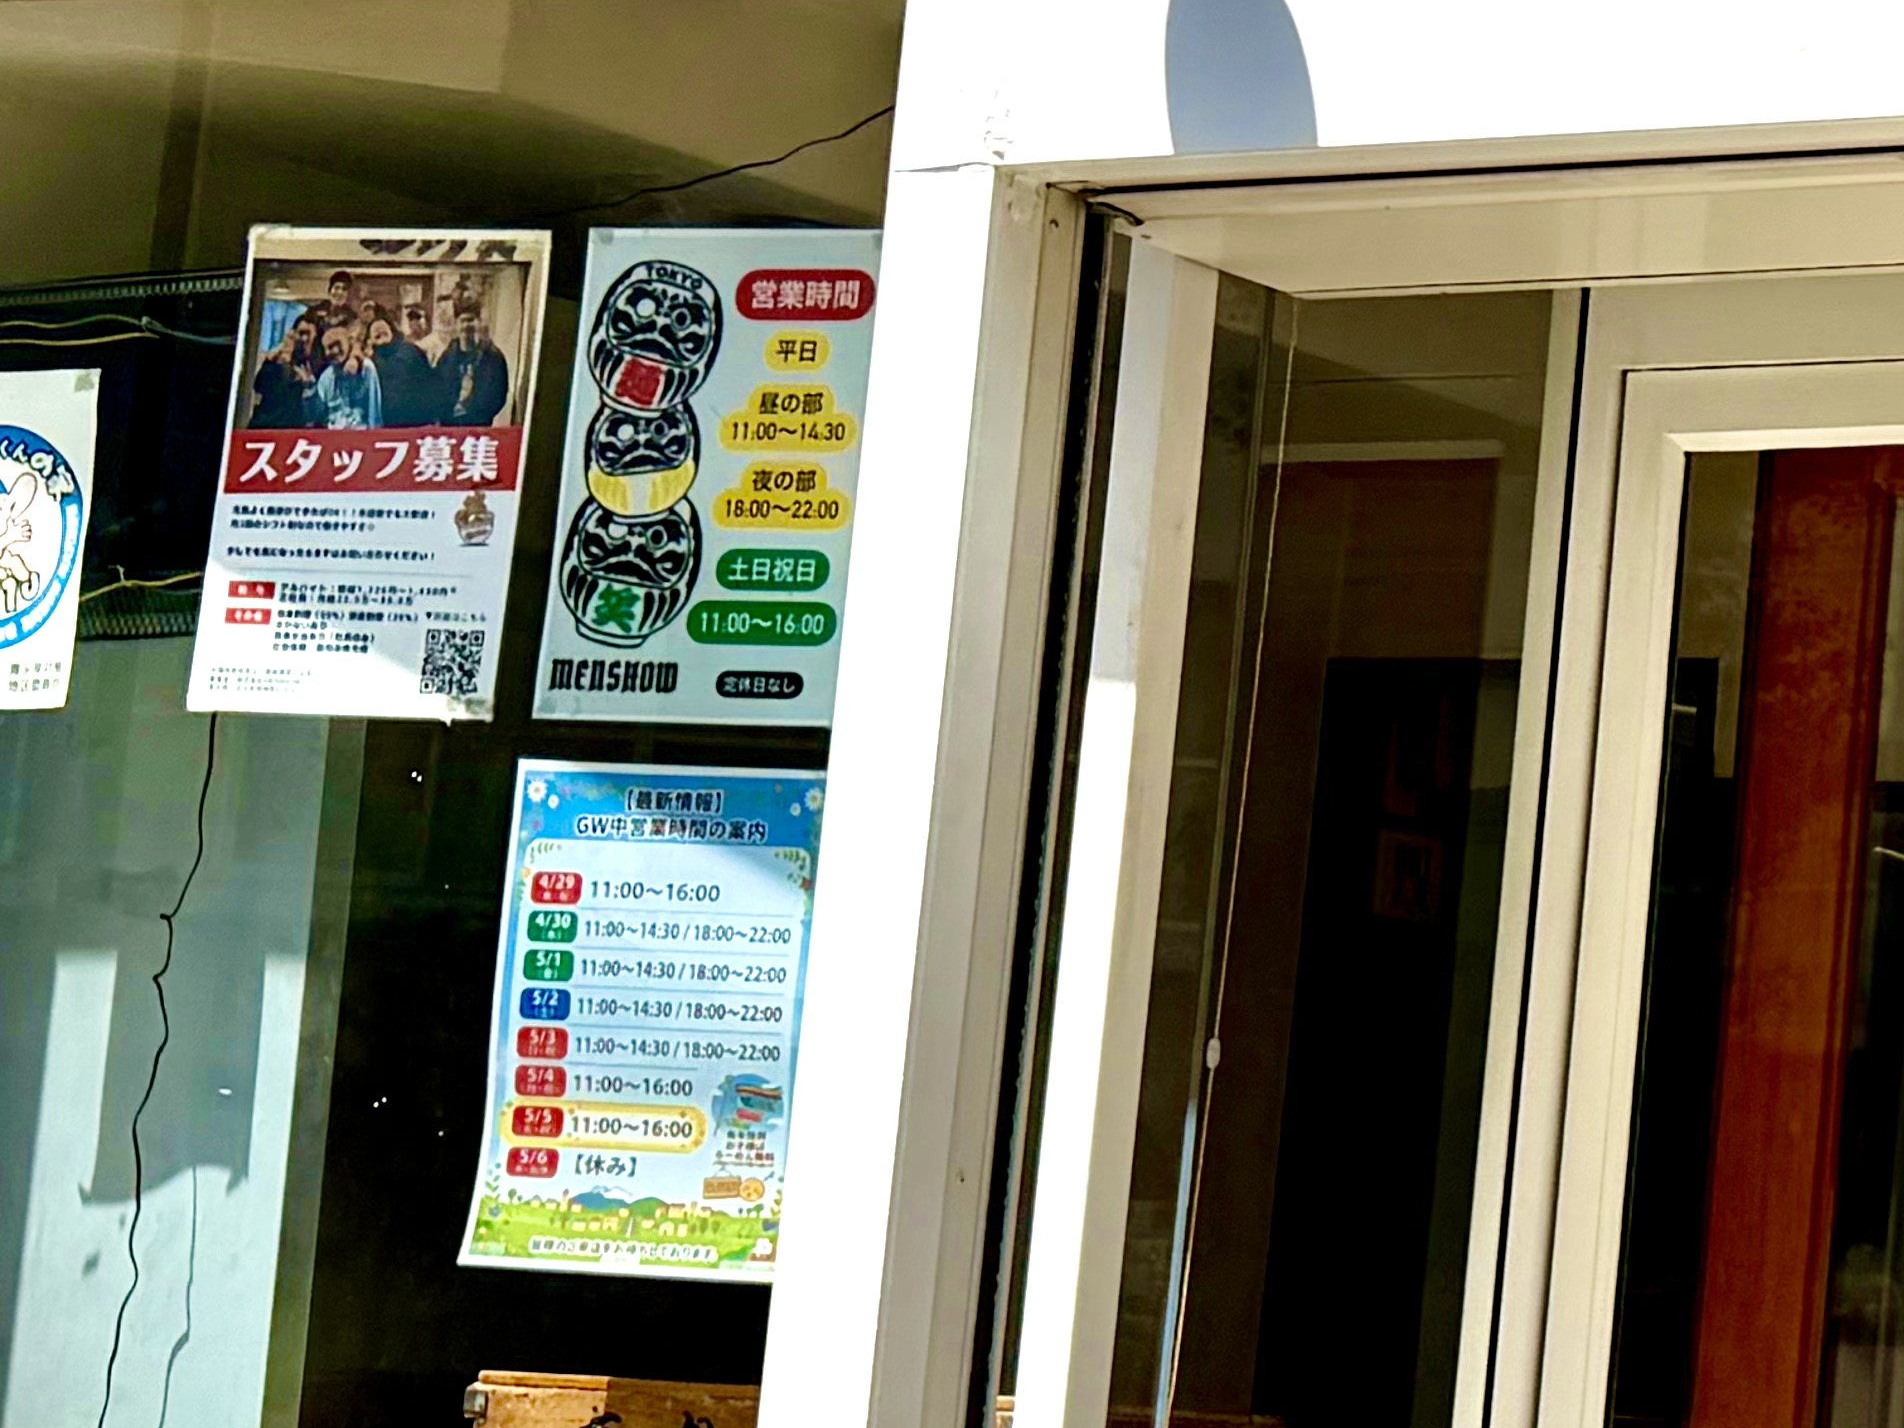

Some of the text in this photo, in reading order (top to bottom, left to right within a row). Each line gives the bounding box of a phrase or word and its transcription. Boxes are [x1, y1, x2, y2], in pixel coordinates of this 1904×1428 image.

[751, 280, 861, 310] 営業時間
[777, 339, 819, 363] 平日
[759, 391, 824, 416] 昼の部
[239, 435, 500, 483] スタッフ募集
[752, 470, 818, 493] 夜の部
[727, 557, 816, 583] 土日祝日
[723, 676, 796, 694] 定休日なし
[576, 816, 767, 842] GW中営業時間の案内
[538, 874, 575, 890] 4/29
[535, 913, 571, 929] 4/30
[536, 952, 561, 967] 5/1
[532, 991, 560, 1006] 5/2
[530, 1028, 556, 1045] 5/3
[527, 1067, 554, 1083] 5/4
[524, 1107, 553, 1123] 5/5
[519, 1149, 548, 1164] 5/6
